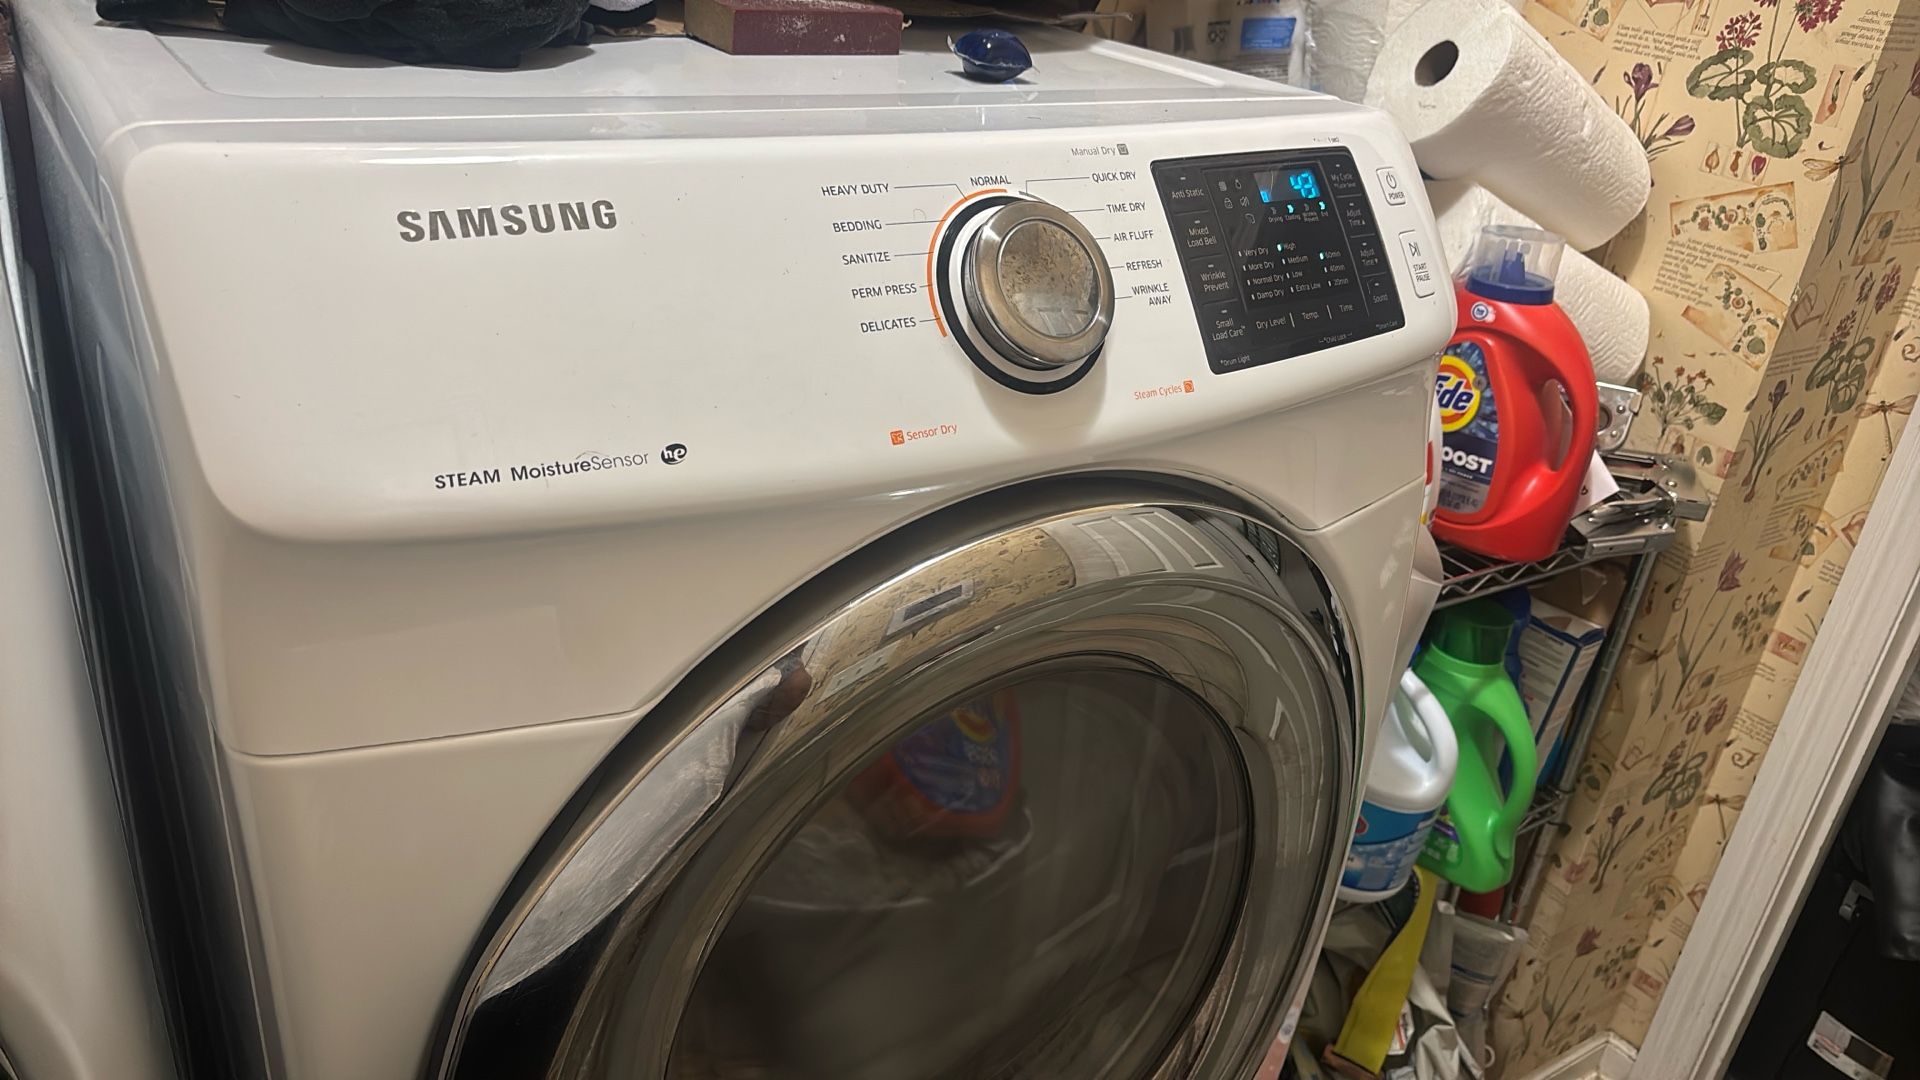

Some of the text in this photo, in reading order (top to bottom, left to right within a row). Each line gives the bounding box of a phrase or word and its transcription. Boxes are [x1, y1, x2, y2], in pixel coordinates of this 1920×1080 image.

[1071, 144, 1116, 157] Manual Dry
[970, 175, 1012, 188] NORMAL
[1091, 170, 1137, 183] QUICK DRY
[821, 183, 889, 198] HEAVY DUTY
[1172, 188, 1204, 199] Anti Static
[1388, 192, 1405, 200] POWER
[1106, 202, 1146, 214] TIME DRY
[396, 200, 618, 243] SAMSUNG
[833, 219, 883, 233] BEDDING
[1113, 230, 1155, 242] AIR FLUFF
[1189, 225, 1209, 236] Mixed
[1187, 236, 1216, 248] Load Bell
[1244, 246, 1269, 257] Very Dry
[842, 252, 891, 266] SANITIZE
[1126, 260, 1163, 271] REFRESH
[1249, 261, 1275, 271] More Dry
[1413, 263, 1428, 271] START
[1200, 271, 1226, 283] Wrinkle
[1253, 273, 1284, 285] Normal Dry
[852, 284, 917, 300] PERM PRESS
[1131, 283, 1170, 296] WRINKLE
[1204, 282, 1229, 294] Prevent
[1257, 288, 1284, 300] Damp Dry
[1296, 284, 1310, 292] Extra
[1148, 295, 1173, 307] AWAY
[1339, 304, 1353, 313] Time
[860, 317, 917, 334] DELICATES
[1216, 318, 1234, 329] Small
[1256, 316, 1287, 330] Dry Level
[1212, 329, 1228, 341] Load
[1133, 383, 1182, 400] Steam Cycles
[906, 424, 958, 442] Sensor Dry
[1442, 446, 1493, 474] OOST
[434, 452, 649, 490] STEAM MoistureSensor
